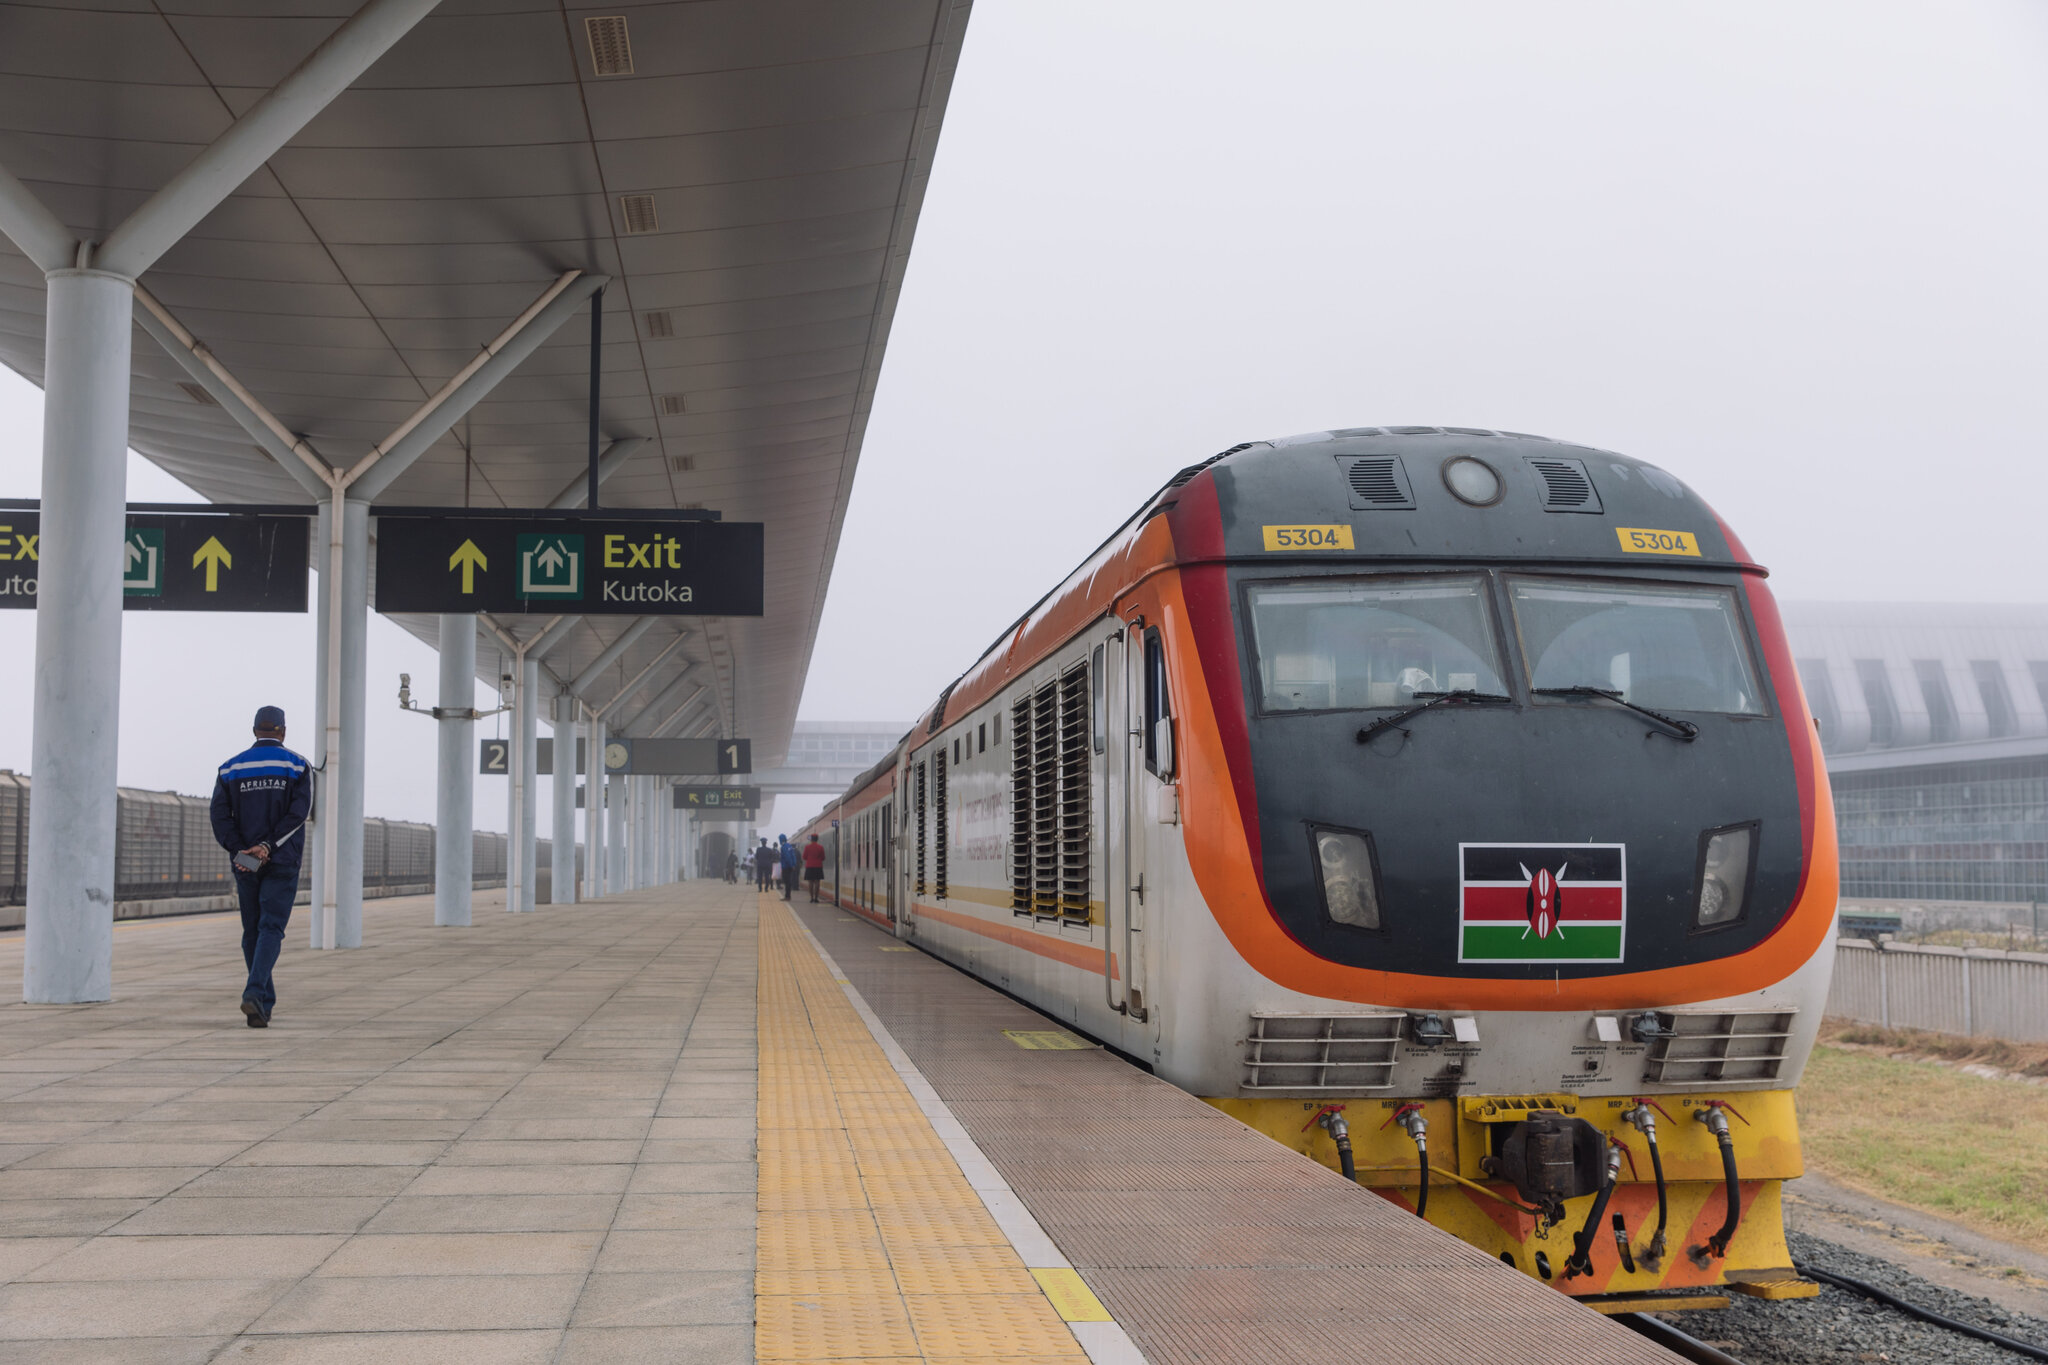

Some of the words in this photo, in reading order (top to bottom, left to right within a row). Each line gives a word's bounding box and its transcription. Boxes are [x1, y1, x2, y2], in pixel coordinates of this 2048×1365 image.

[0, 525, 40, 560] Ex
[1277, 529, 1339, 547] 5304
[1630, 531, 1688, 552] 5304
[603, 533, 682, 569] Exit
[0, 574, 39, 596] uto
[603, 580, 693, 602] Kutoka
[488, 744, 505, 769] 2
[725, 744, 738, 769] 1
[240, 779, 287, 790] AFRISTAR
[723, 790, 742, 799] Exit
[743, 808, 750, 819] 1
[1682, 1099, 1692, 1107] EP
